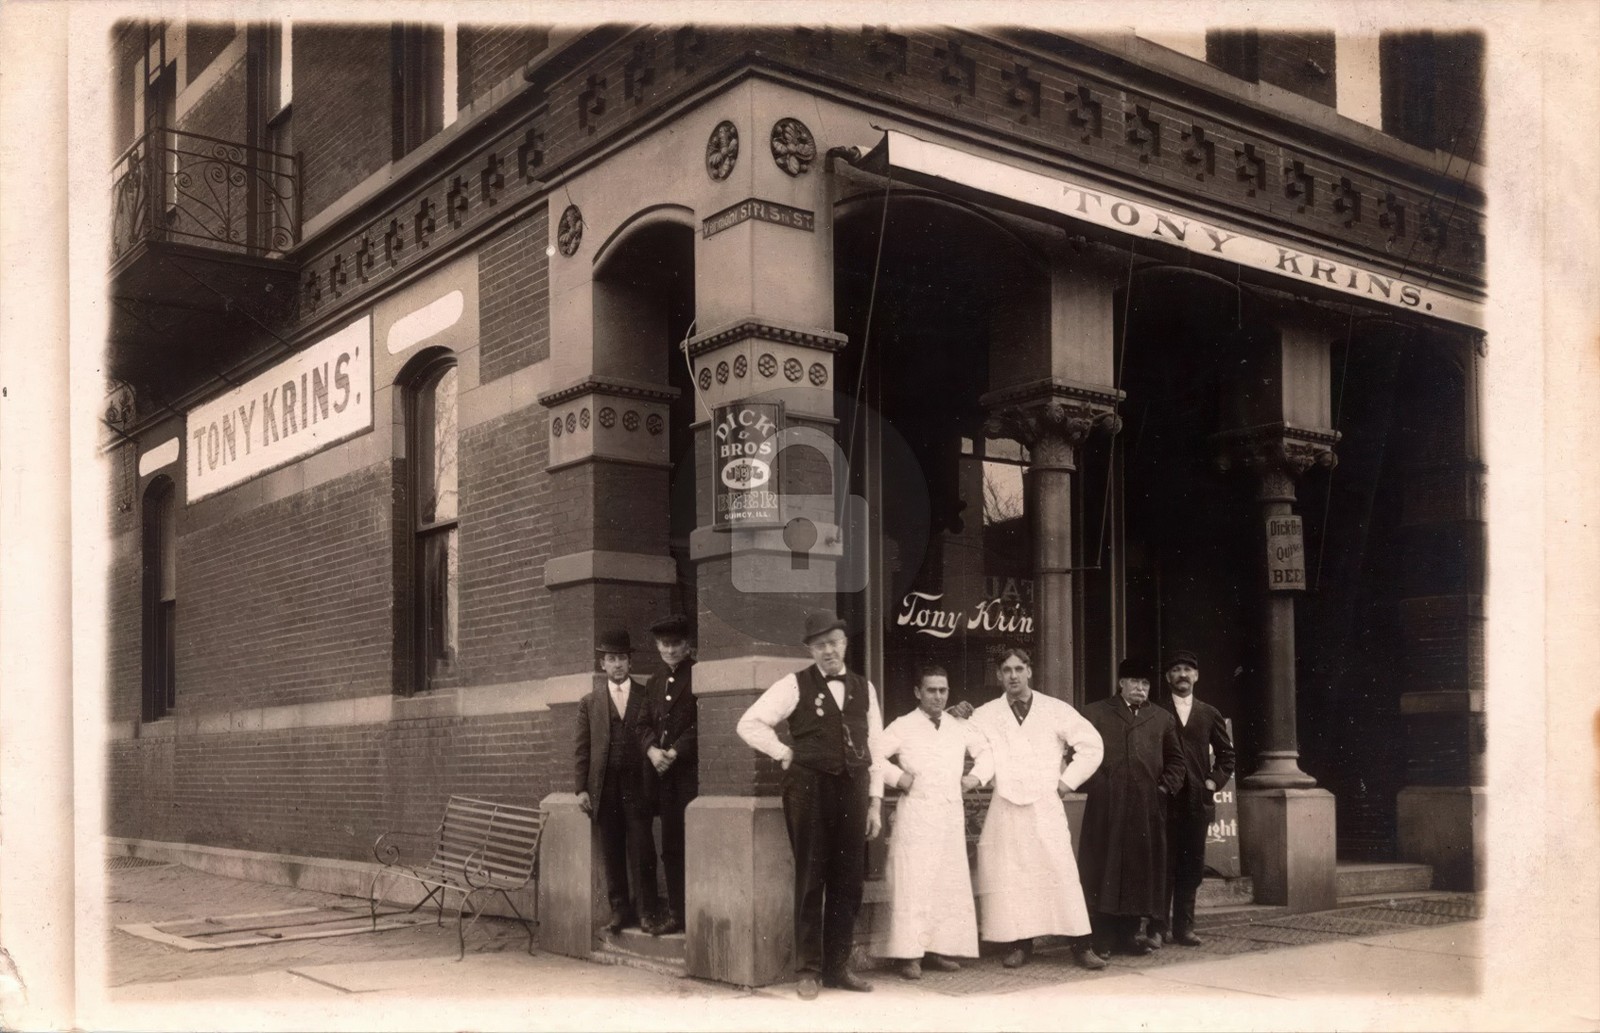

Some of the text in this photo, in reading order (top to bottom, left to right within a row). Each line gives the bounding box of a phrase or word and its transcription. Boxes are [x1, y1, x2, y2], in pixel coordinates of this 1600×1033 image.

[1063, 186, 1433, 311] TONY KRINS.
[193, 399, 256, 477] TONY
[716, 409, 776, 441] DICK
[738, 430, 750, 439] &
[720, 442, 772, 458] BROS
[717, 490, 778, 512] BEER
[897, 591, 962, 639] Tony
